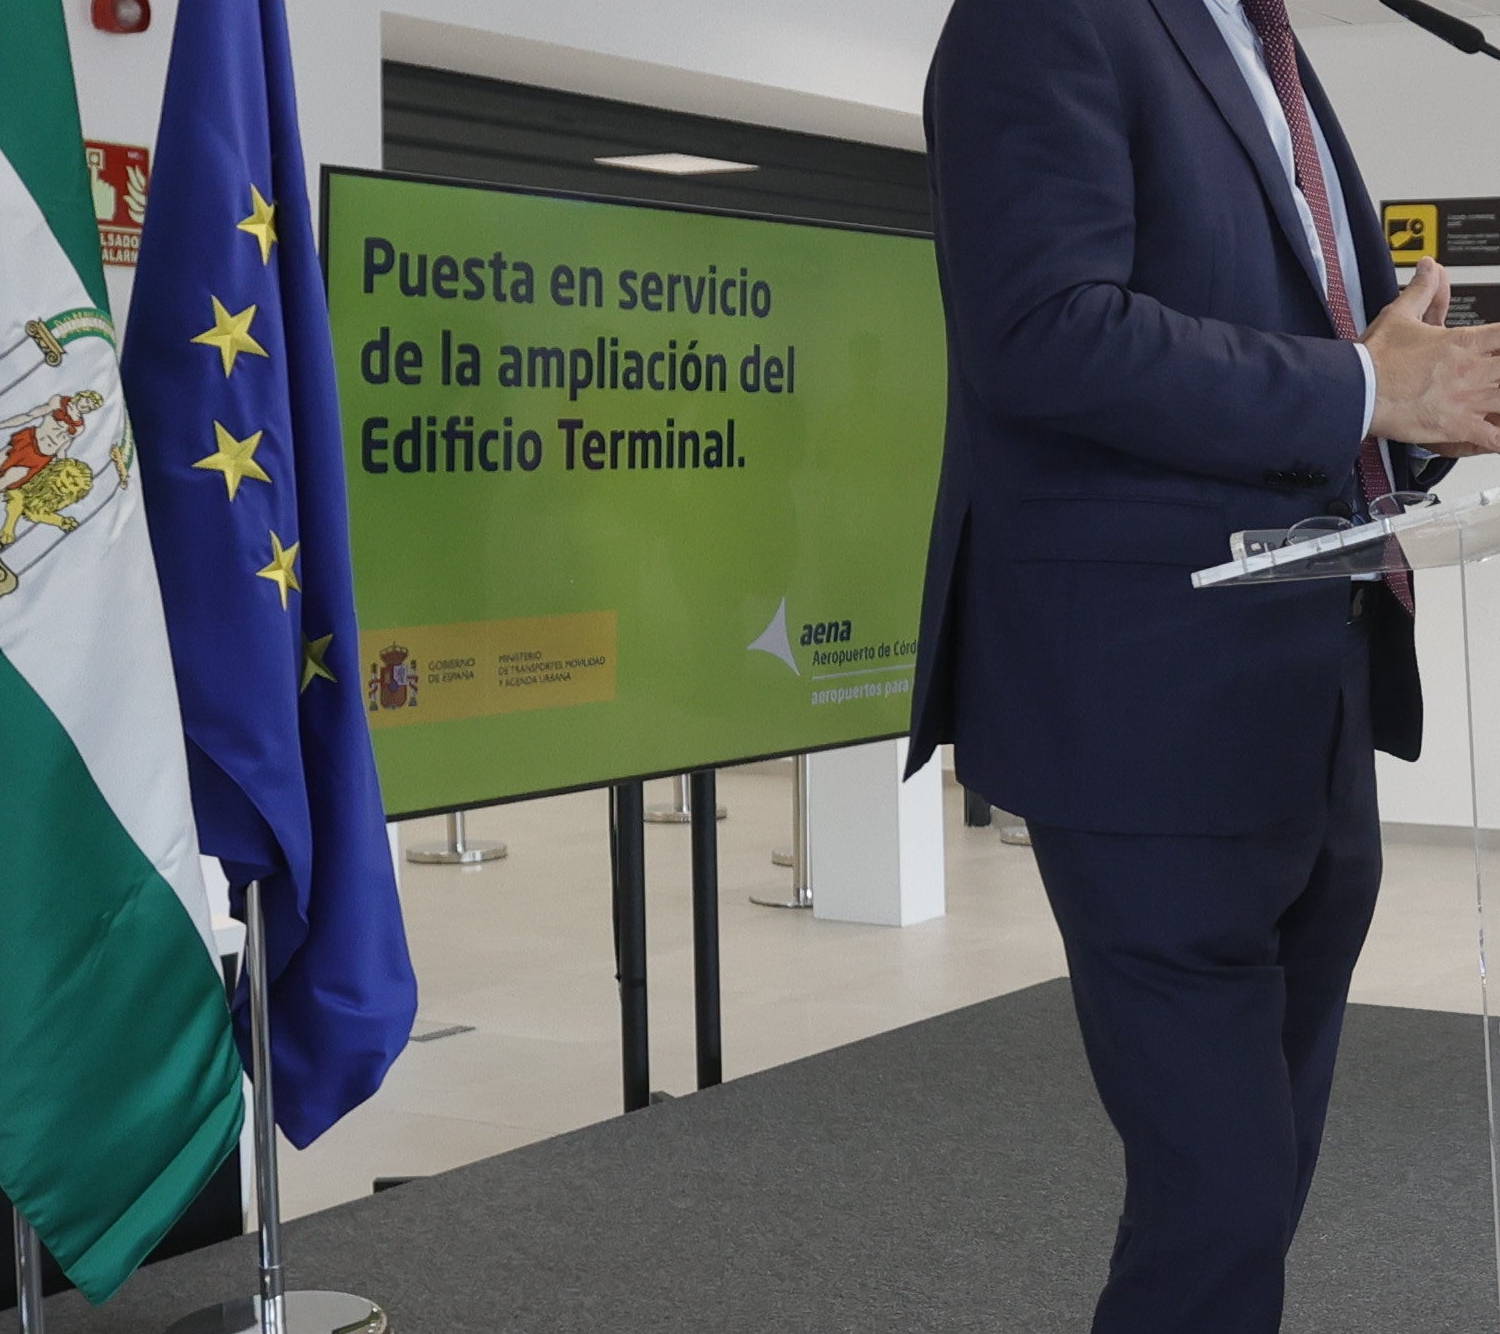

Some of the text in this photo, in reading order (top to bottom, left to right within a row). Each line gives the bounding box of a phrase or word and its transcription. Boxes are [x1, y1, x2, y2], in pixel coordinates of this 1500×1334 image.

[100, 231, 140, 249] LSADO
[363, 236, 772, 319] Puesta en servicio
[360, 325, 795, 402] de la ampliación del
[361, 415, 746, 475] Edificio Terminal.
[800, 619, 853, 647] aena
[428, 657, 476, 671] GOBIERNO
[498, 650, 543, 663] MINISTERIO
[812, 639, 918, 667] Aeropuerto de Córd
[428, 673, 440, 684] DE
[811, 677, 911, 706] aeropuertos para
